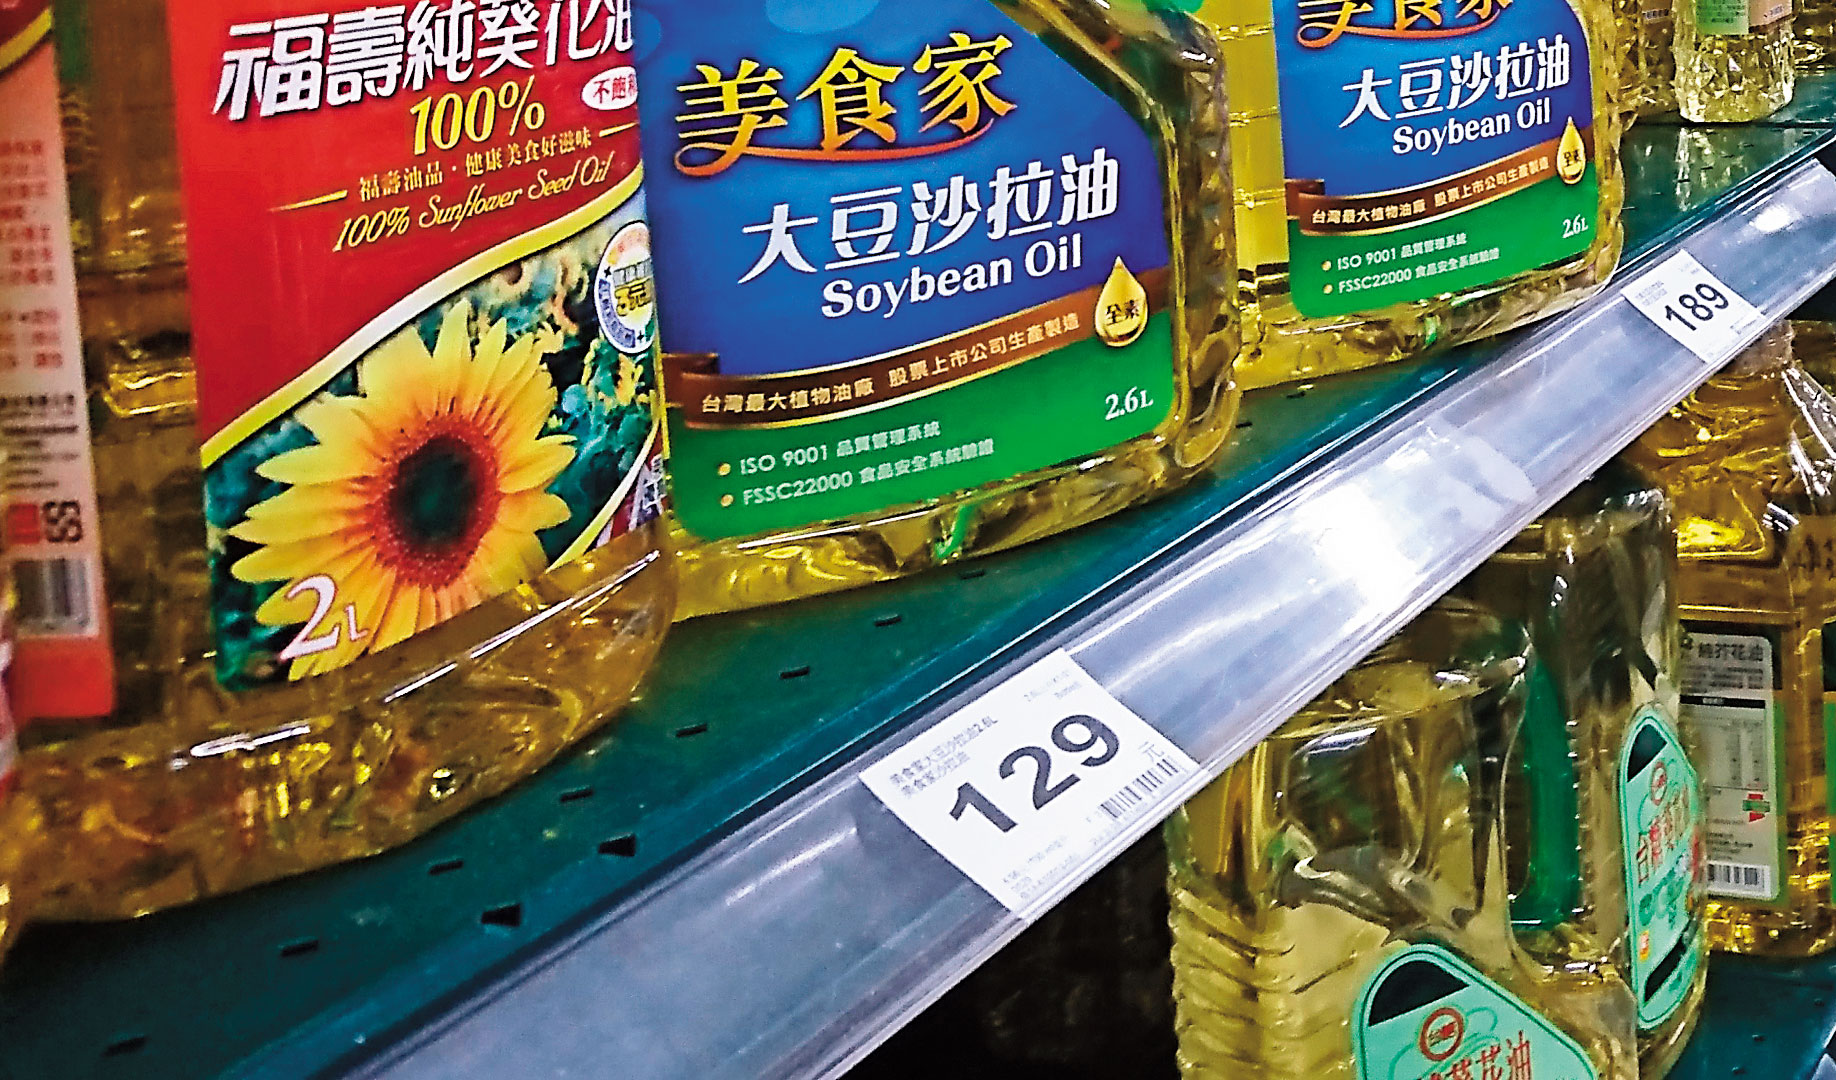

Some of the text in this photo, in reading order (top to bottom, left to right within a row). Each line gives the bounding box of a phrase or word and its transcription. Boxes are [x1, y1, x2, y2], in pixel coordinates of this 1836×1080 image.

[409, 74, 546, 156] 100%
[674, 32, 1017, 177] 美食家
[1338, 33, 1570, 129] 大豆沙拉油
[1392, 96, 1551, 156] Soybean Oil
[332, 150, 616, 253] 100% Sunflower Seed Oil
[738, 147, 1119, 285] 大豆沙拉油
[821, 233, 1082, 318] Soybean Oil
[1337, 255, 1362, 271] ISO
[1365, 247, 1397, 266] 9001
[1338, 267, 1412, 294] FSSC22000
[1105, 302, 1140, 326] 全素
[1664, 283, 1729, 331] 189
[701, 312, 1081, 413] 台灣最大植物油廠 股票上市公司生產製造
[1105, 386, 1154, 421] 2.6L
[740, 420, 941, 476] ISO 9001 品質管理系統
[743, 469, 853, 506] FSSC22000
[280, 574, 365, 660] 2L
[949, 715, 1120, 833] 129
